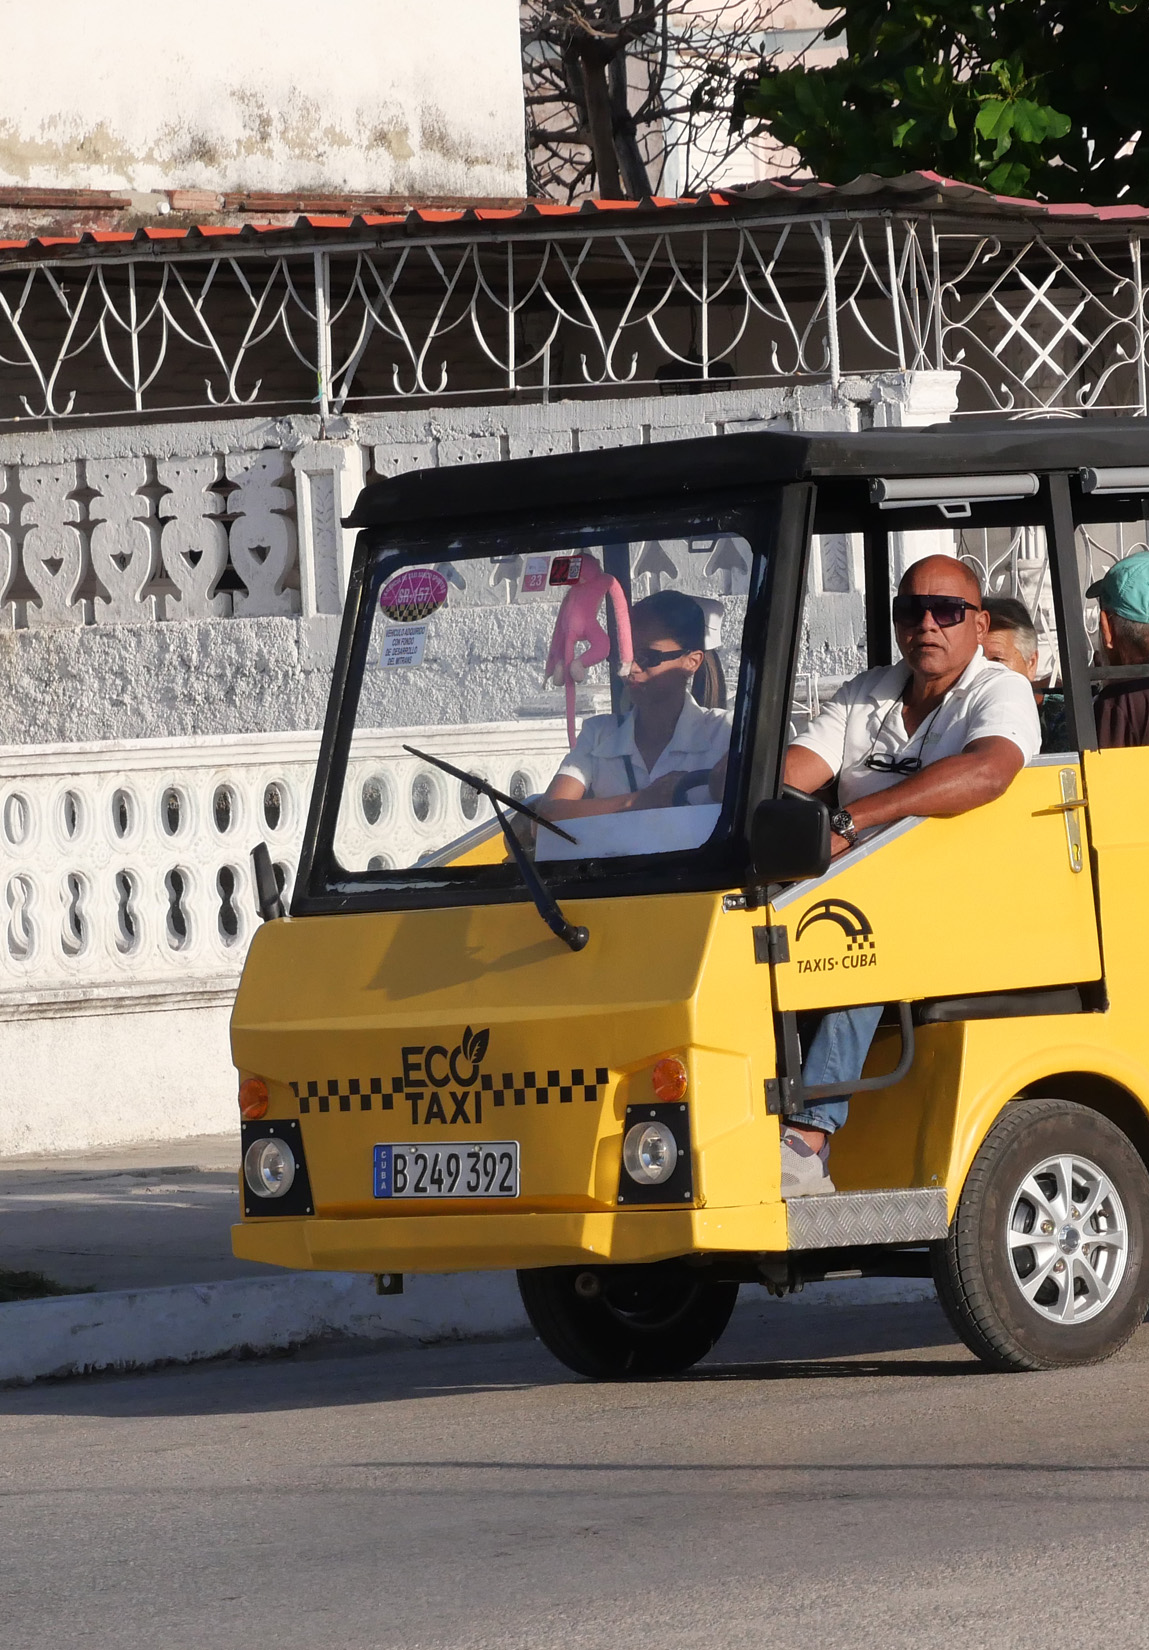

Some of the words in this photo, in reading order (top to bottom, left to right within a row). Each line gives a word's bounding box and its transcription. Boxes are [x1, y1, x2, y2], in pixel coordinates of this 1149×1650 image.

[529, 575, 543, 587] 23
[385, 648, 392, 656] DE
[392, 646, 418, 656] DESARROLLO
[842, 953, 877, 969] CUBA
[401, 1045, 480, 1088] ECO
[405, 1090, 482, 1125] TAXI
[466, 1151, 513, 1193] 392
